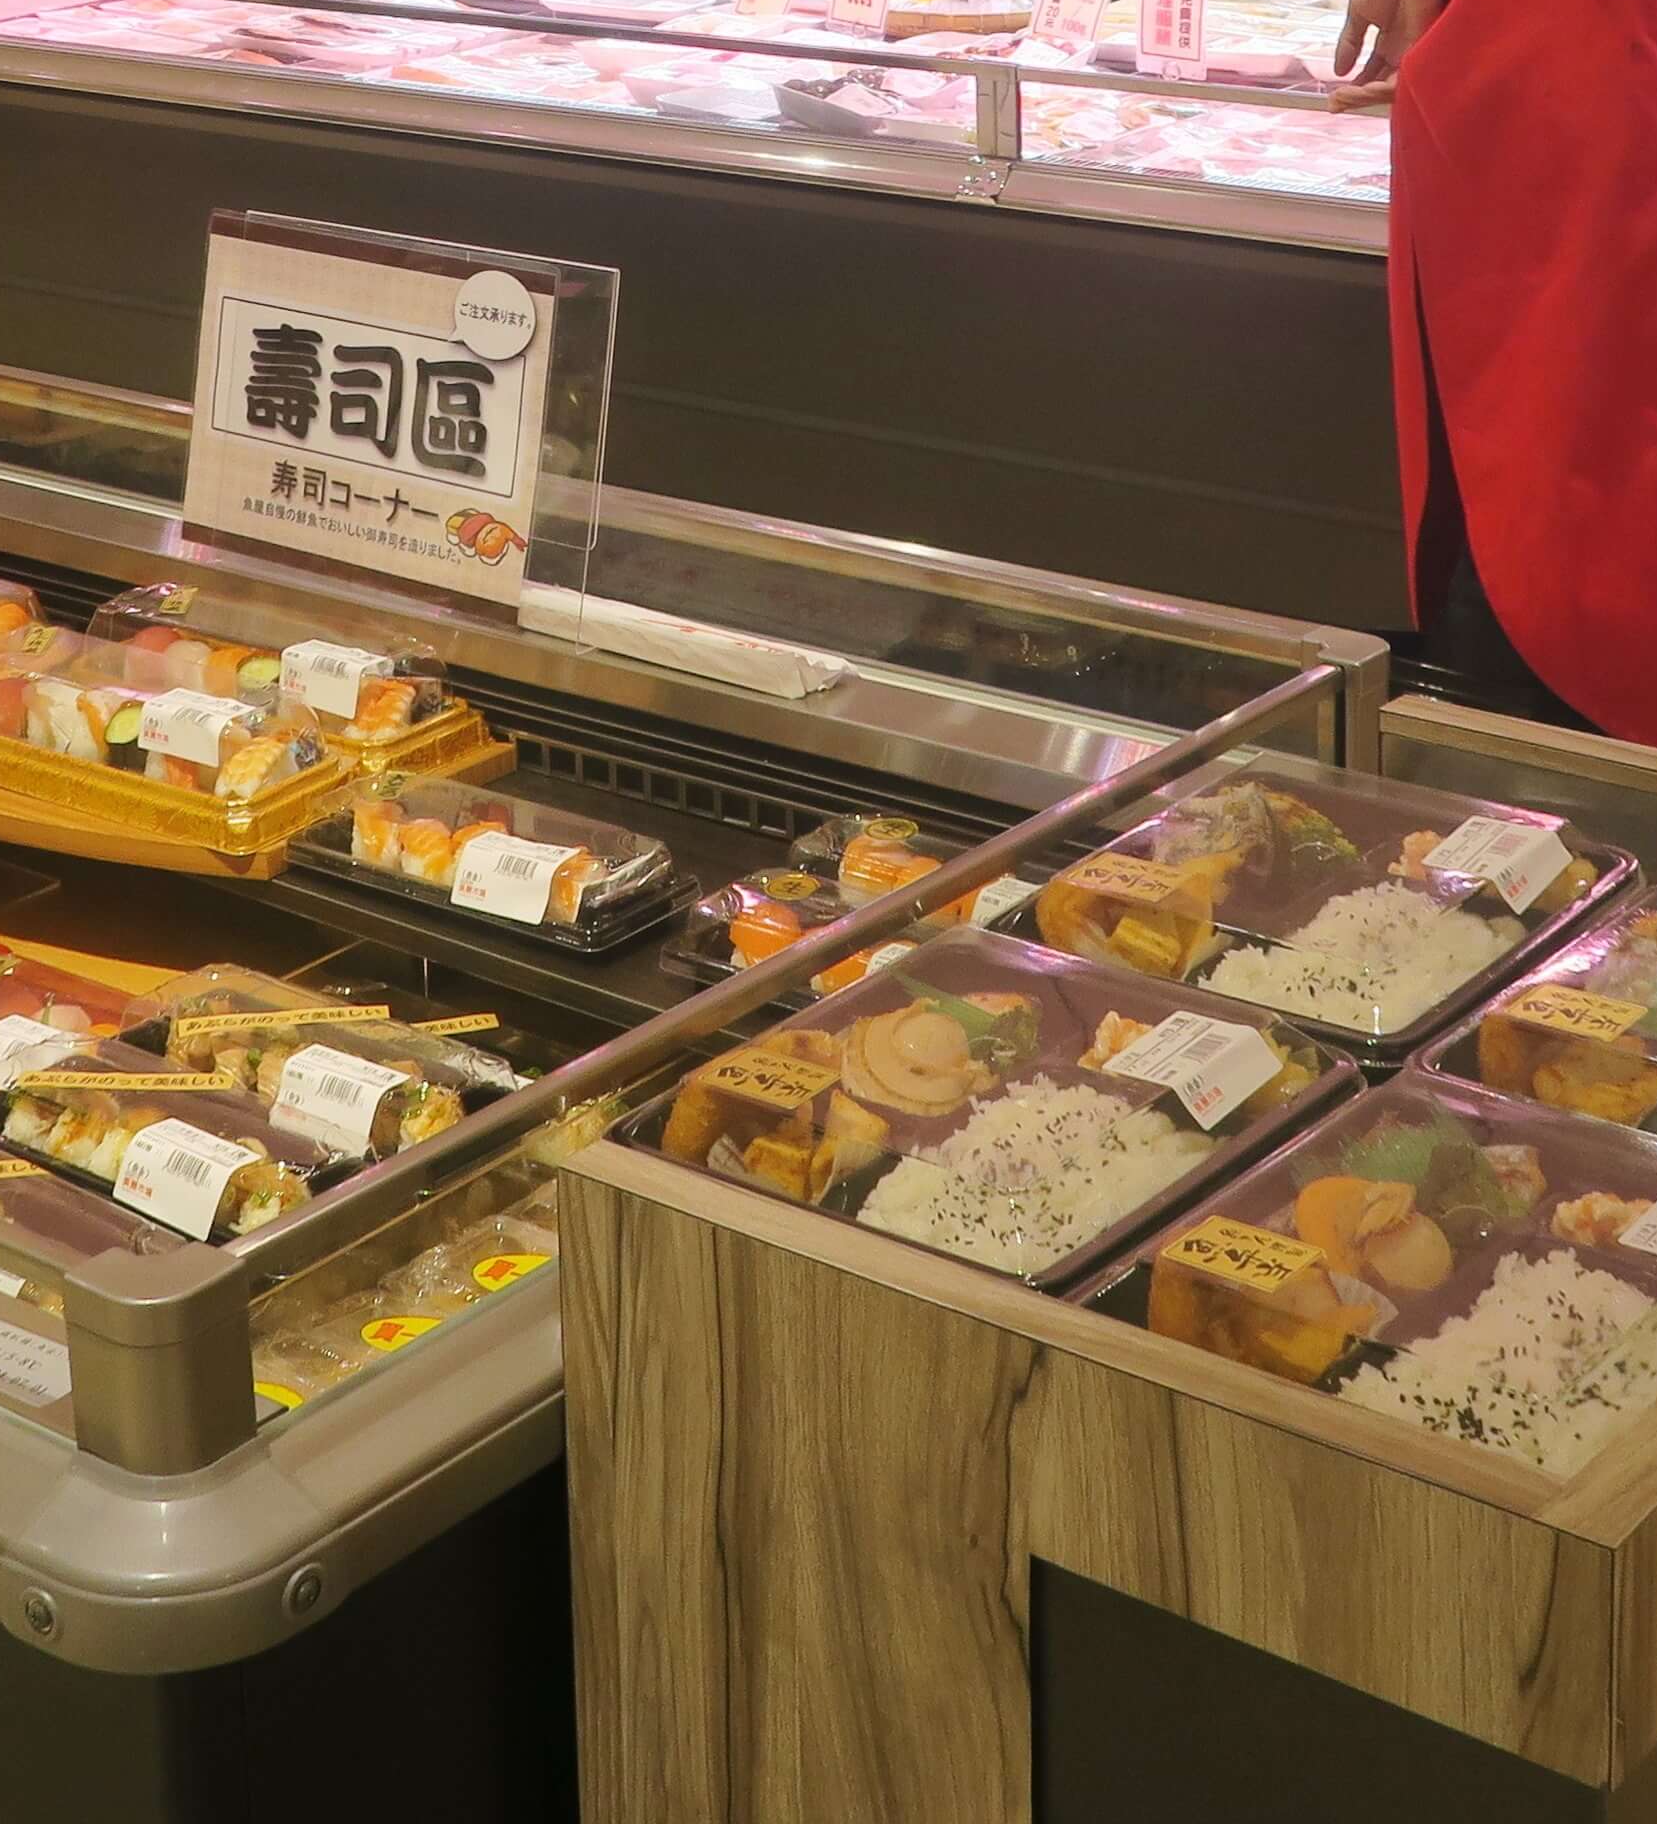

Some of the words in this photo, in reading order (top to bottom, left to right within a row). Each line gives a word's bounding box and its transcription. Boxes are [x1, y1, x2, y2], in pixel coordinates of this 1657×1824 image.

[244, 323, 495, 476] 壽司區
[270, 459, 440, 523] 寿司コーナー
